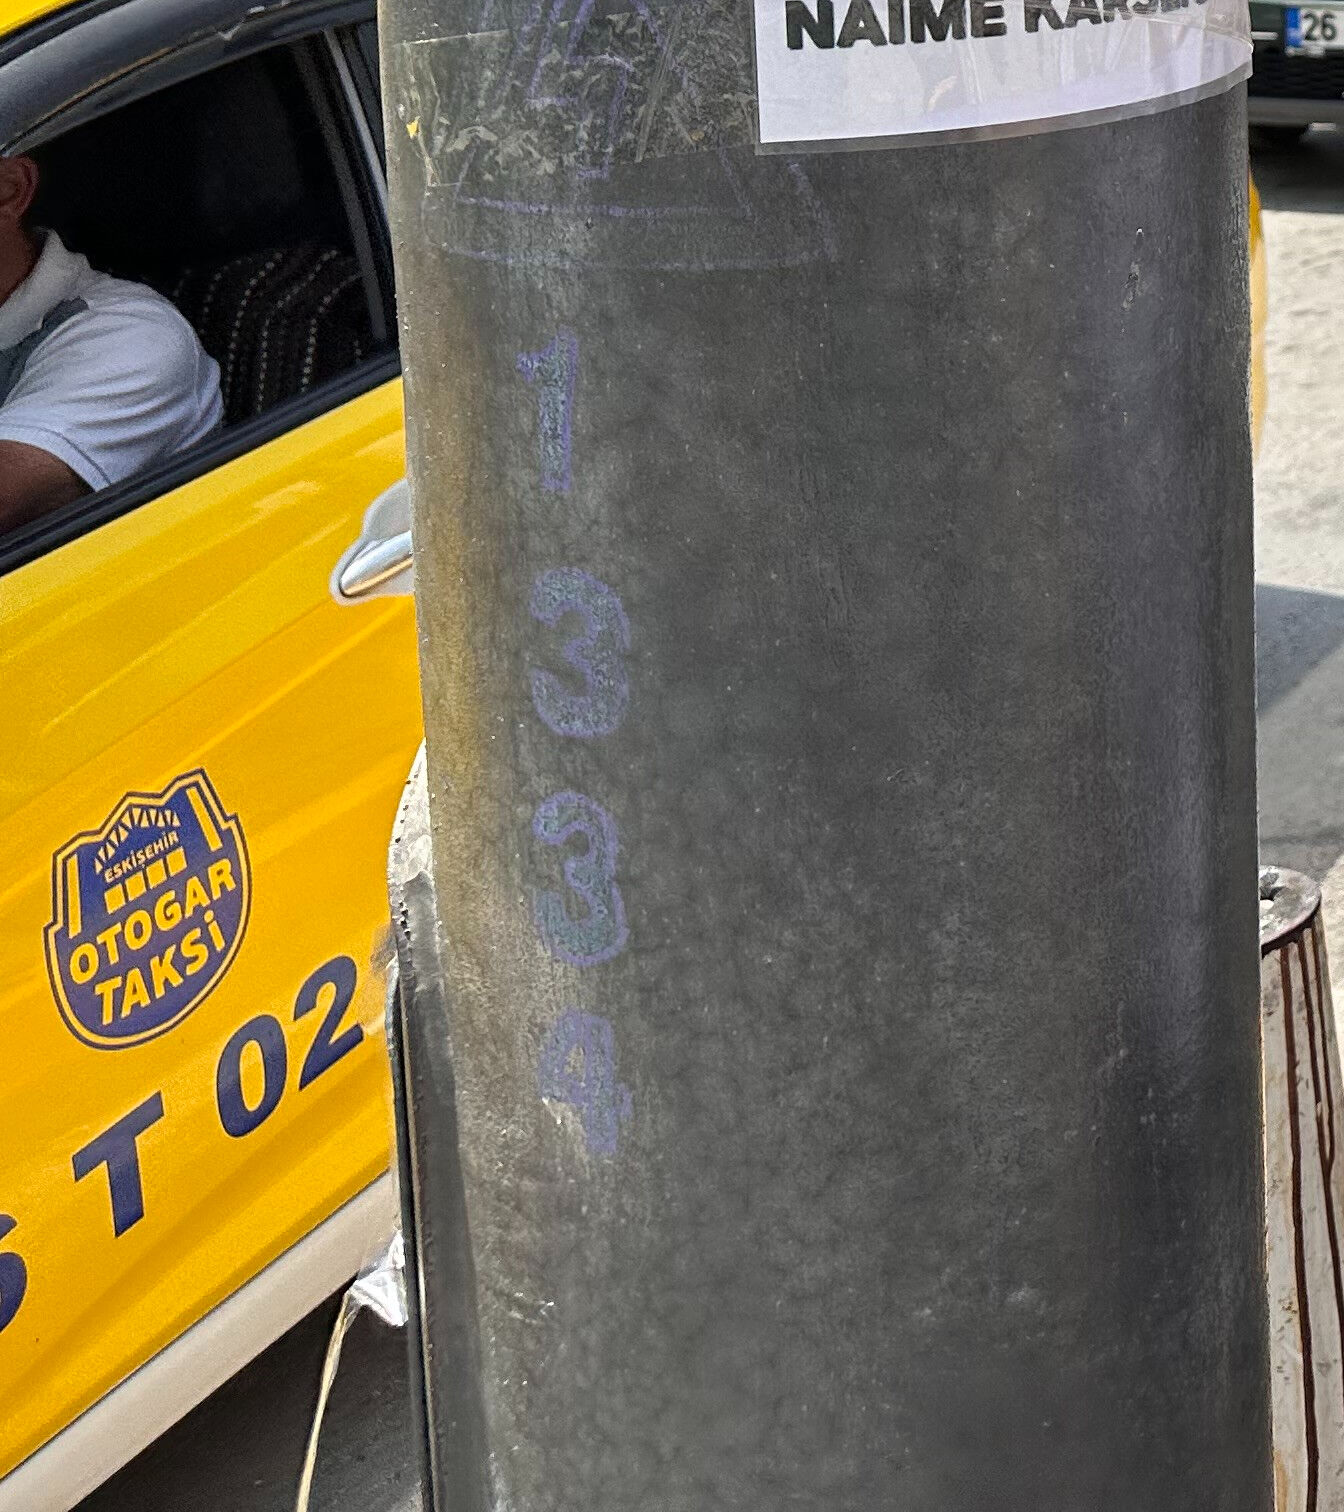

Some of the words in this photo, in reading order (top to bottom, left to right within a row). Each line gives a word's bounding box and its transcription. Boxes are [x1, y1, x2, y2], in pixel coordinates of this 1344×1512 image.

[1303, 12, 1337, 42] 26
[104, 830, 179, 884] ESKİŞEHİR
[69, 857, 237, 986] OTOGAR
[94, 909, 226, 1028] TAKSİ
[72, 1090, 165, 1239] T
[216, 954, 365, 1139] 02
